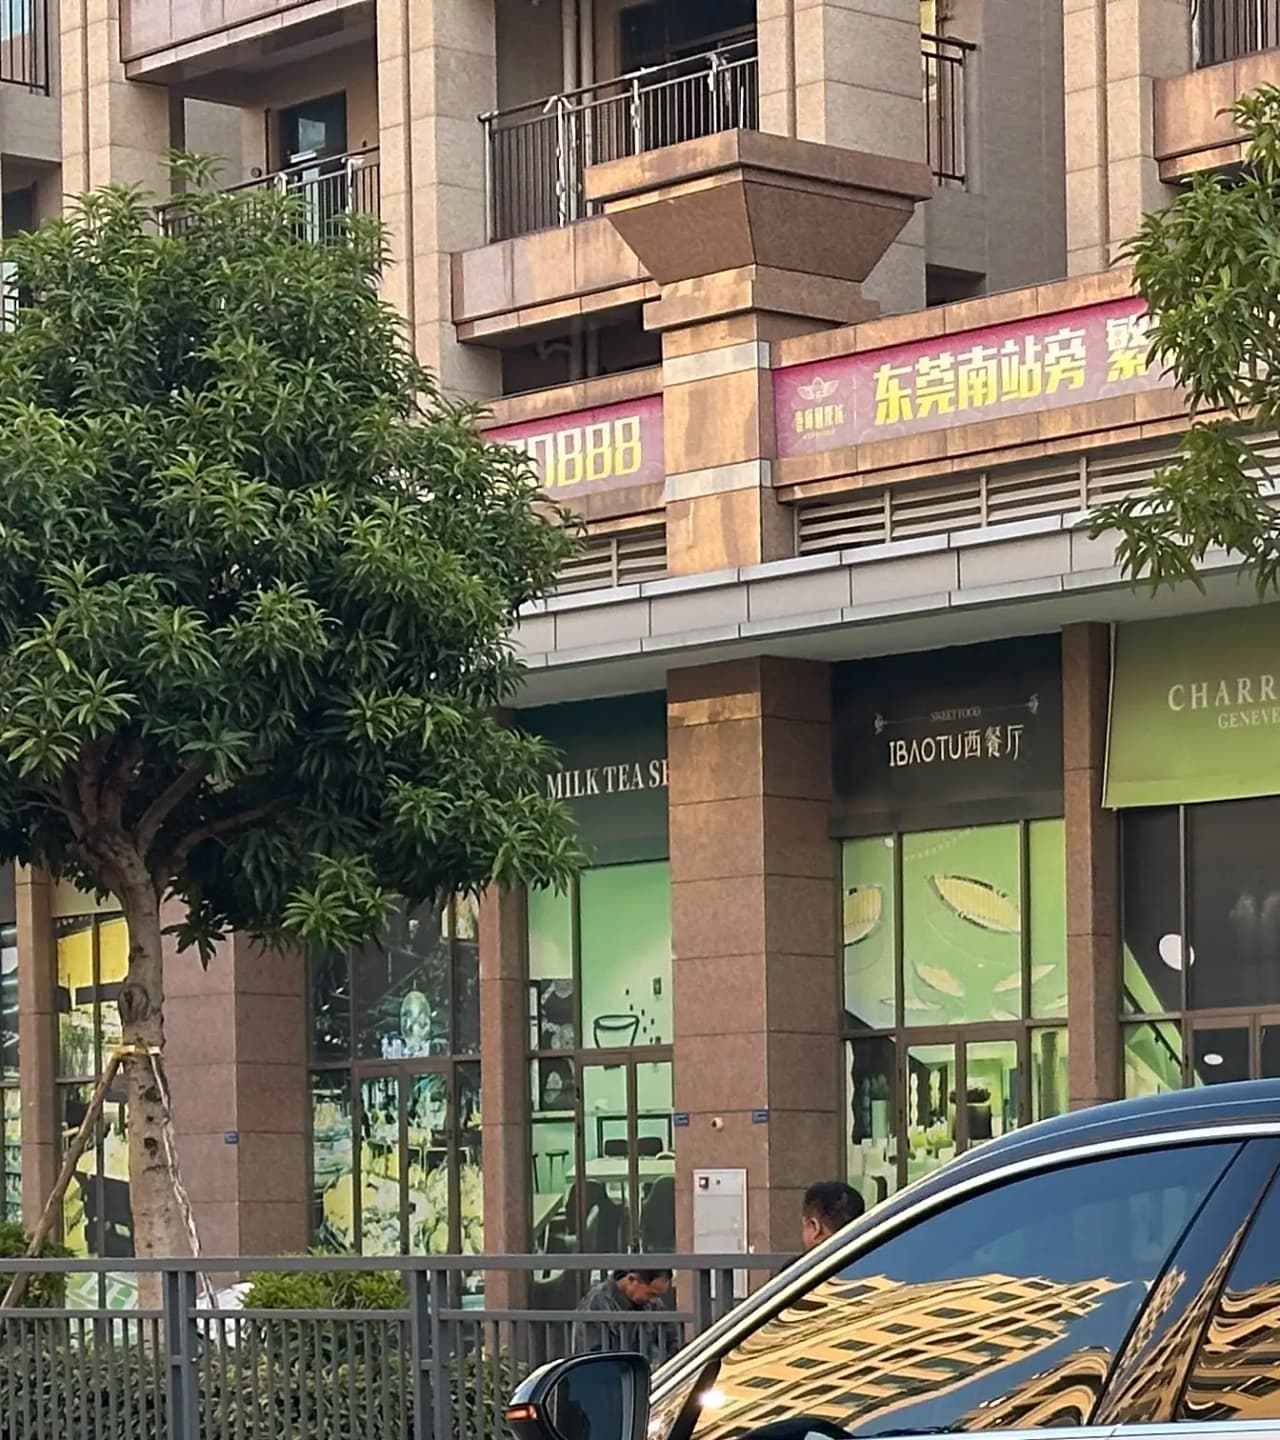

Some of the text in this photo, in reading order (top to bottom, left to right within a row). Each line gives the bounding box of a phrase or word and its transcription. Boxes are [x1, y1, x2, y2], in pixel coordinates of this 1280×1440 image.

[873, 327, 1087, 426] 东莞南站旁
[500, 416, 642, 489] 0888
[546, 767, 600, 800] MILK
[603, 762, 645, 793] TEA
